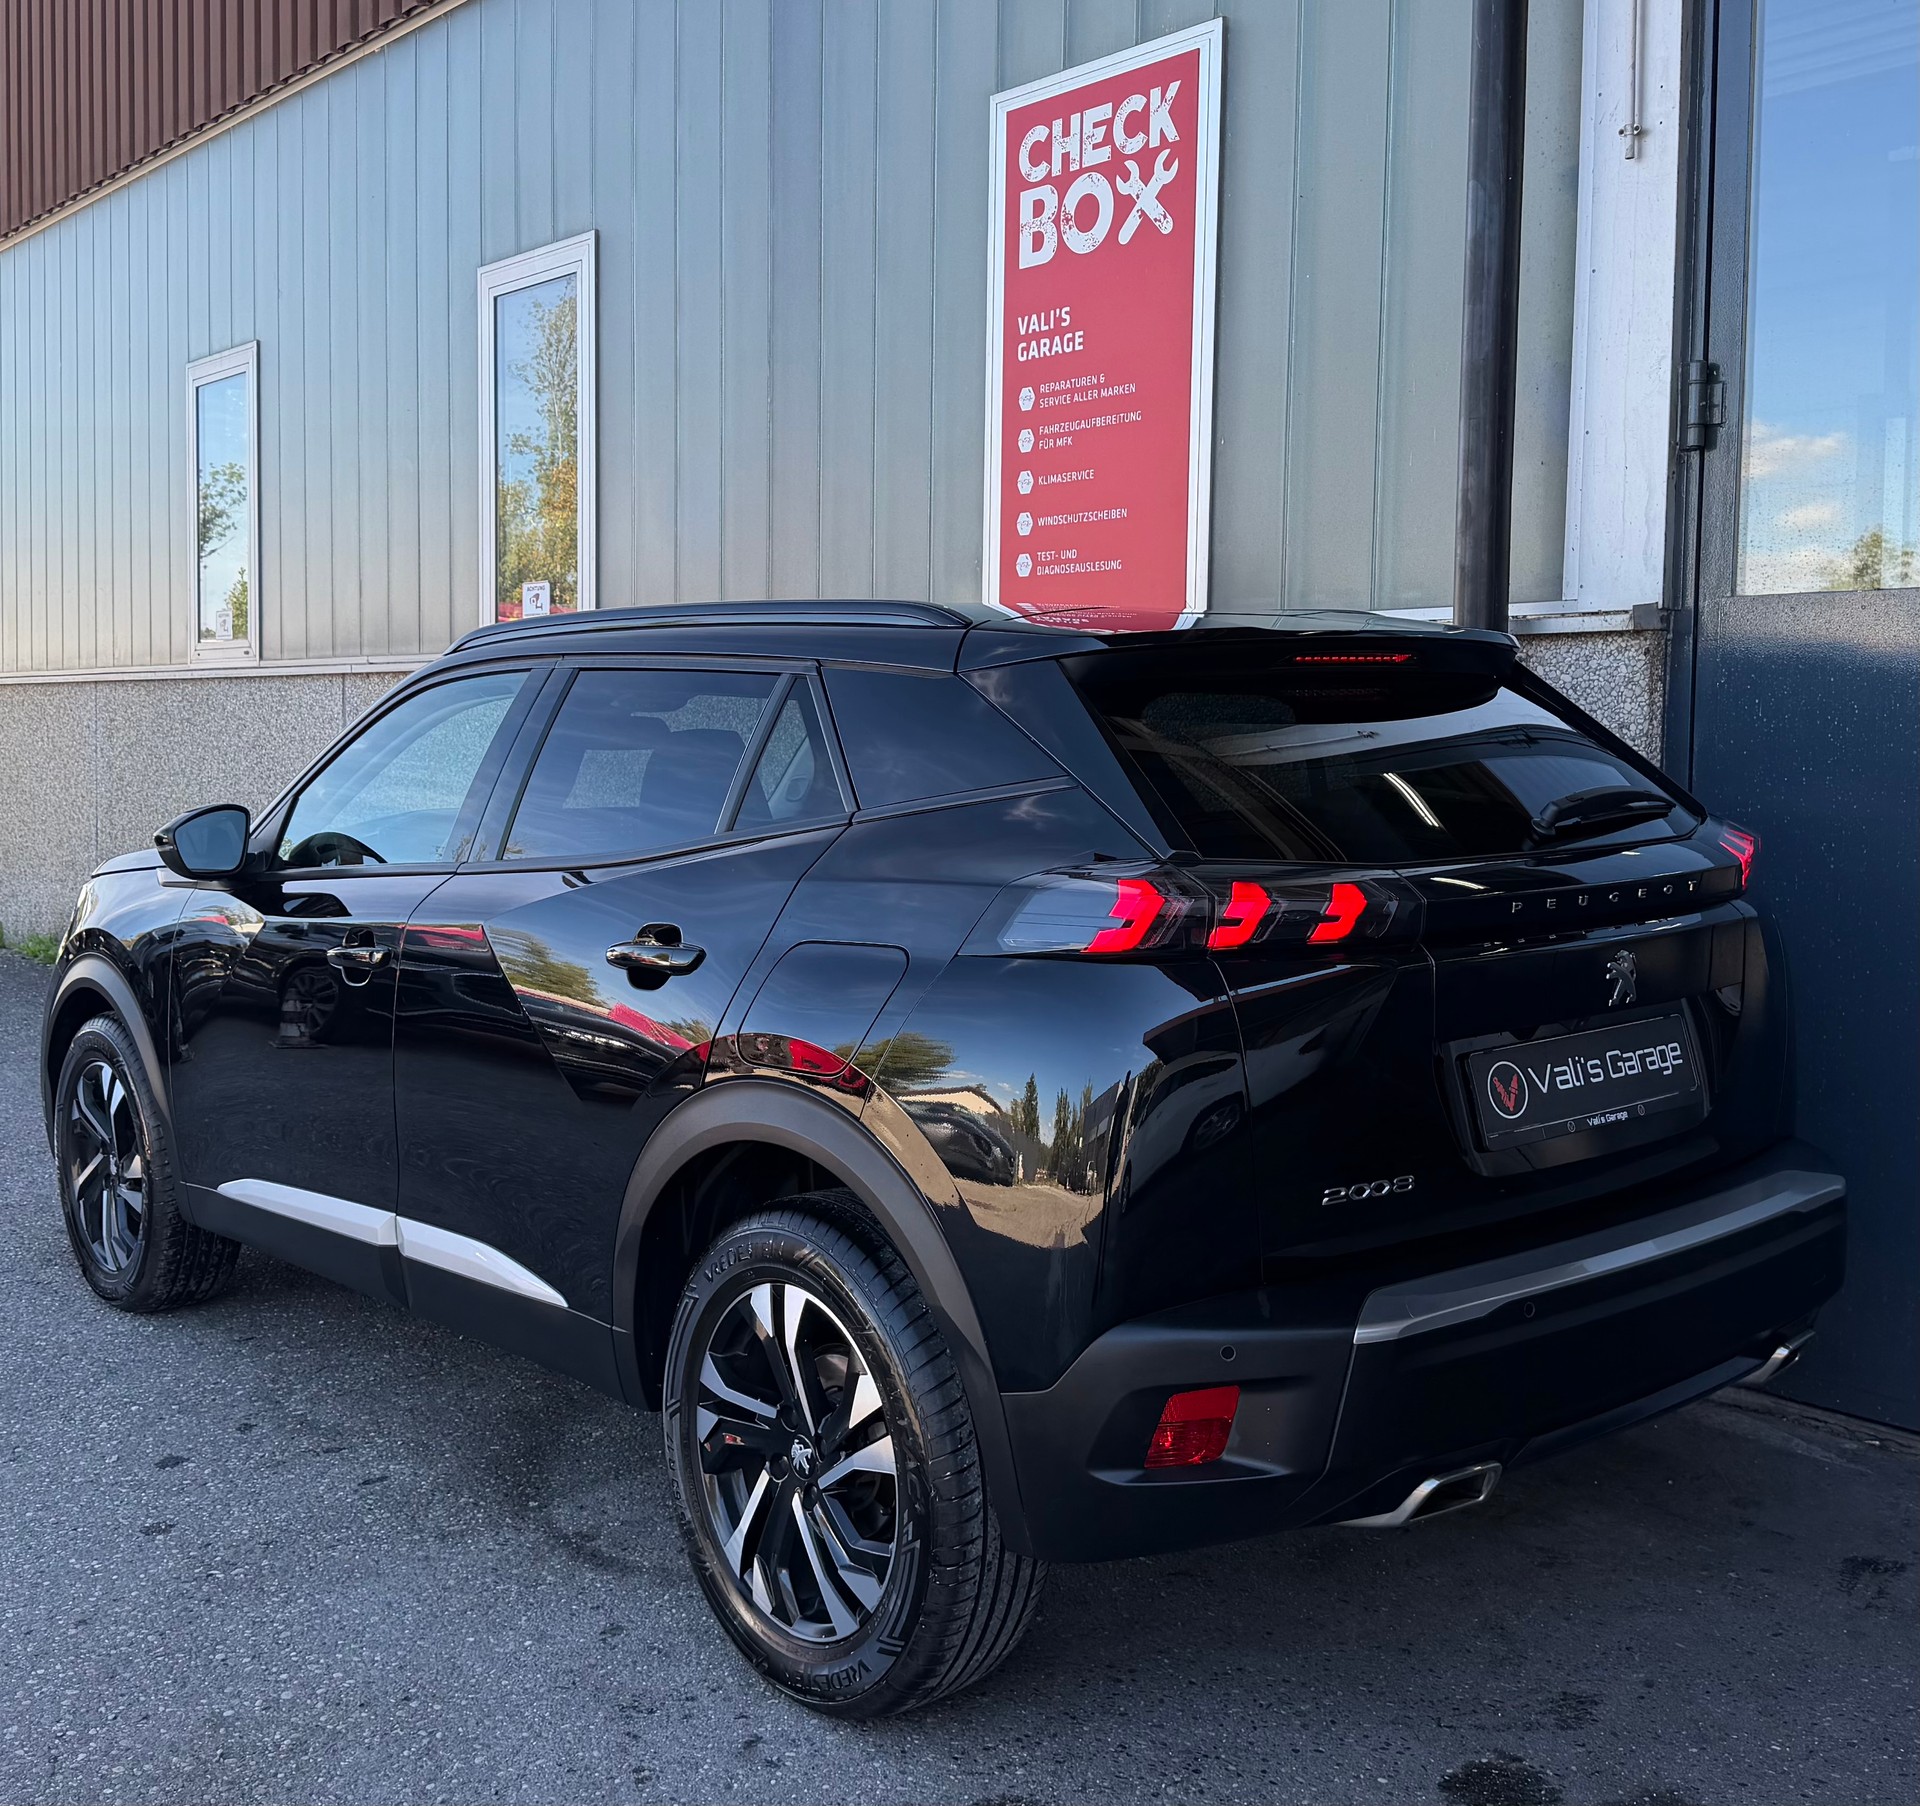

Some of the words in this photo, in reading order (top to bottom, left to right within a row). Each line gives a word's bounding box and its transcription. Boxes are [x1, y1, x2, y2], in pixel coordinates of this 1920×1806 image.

[1018, 79, 1182, 183] CHECK
[1017, 306, 1071, 336] VALI'S
[1017, 330, 1084, 362] GARAGE
[1039, 374, 1098, 394] REPARATUREN
[1099, 373, 1106, 384] &
[1039, 394, 1071, 409] SERVICE
[1073, 389, 1099, 403] ALLER
[1100, 383, 1136, 399] MARKEN
[1039, 410, 1142, 435] FAHRZEUGAUFBEREITUNG
[1038, 437, 1054, 450] FÜR
[1038, 469, 1095, 486] KLIMASERVICE
[1037, 508, 1128, 527] WINDSCHUTZSCHEIBEN
[1036, 551, 1059, 562] TEST-
[1060, 549, 1078, 560] UND
[1036, 559, 1122, 576] DIAGNOSEAUSLESUNG
[1511, 880, 1698, 914] PEUGEOT
[1527, 1056, 1604, 1094] Vali's
[1605, 1042, 1684, 1079] Garage
[1605, 1110, 1629, 1123] Garage
[1321, 1174, 1415, 1206] 2008
